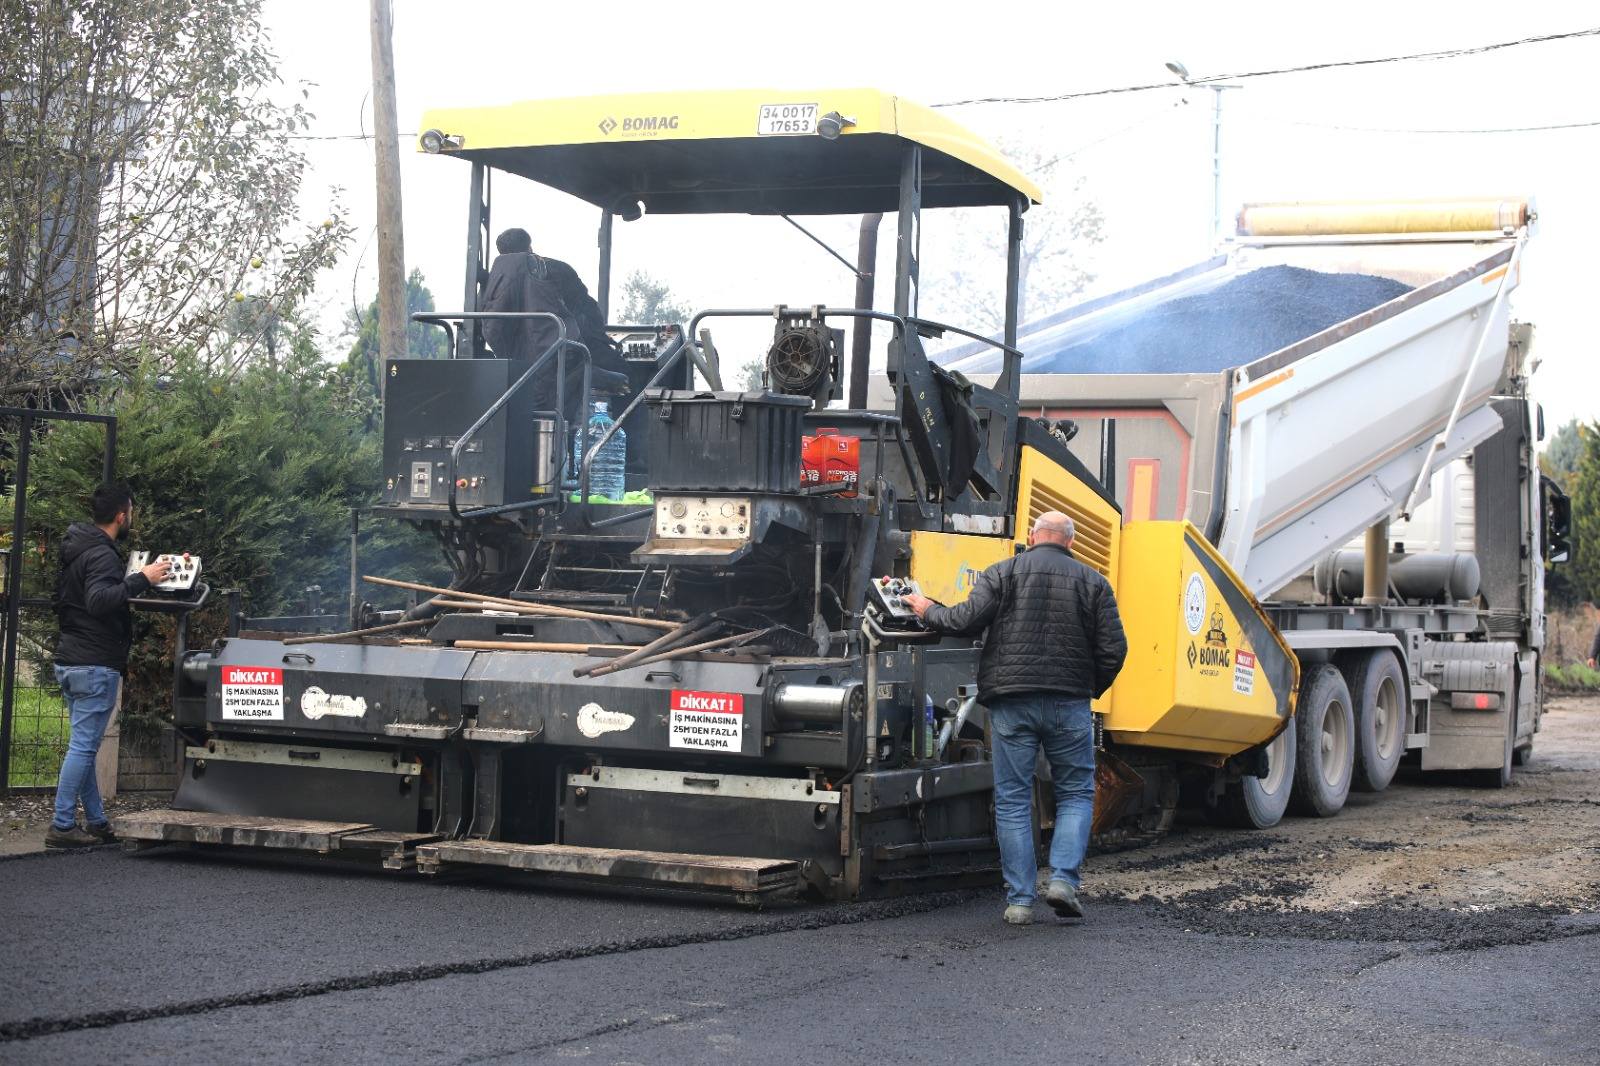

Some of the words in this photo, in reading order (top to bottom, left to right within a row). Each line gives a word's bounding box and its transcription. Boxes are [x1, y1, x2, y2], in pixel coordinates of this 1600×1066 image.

[764, 107, 778, 119] 34
[622, 116, 679, 131] BOMAG
[771, 120, 809, 132] 17653
[1200, 647, 1230, 668] BOMAG
[230, 669, 269, 683] DİKKAT
[226, 686, 233, 696] İŞ
[234, 686, 279, 696] MAKİNASINA
[225, 698, 256, 706] 25M'DEN
[256, 698, 280, 706] FAZLA
[680, 693, 727, 711] DİKKAT
[233, 709, 273, 718] YAKLAŞMA
[674, 712, 683, 723] İŞ
[684, 713, 738, 725] MAKİNASINA
[673, 725, 710, 735] 25M'DEN
[710, 727, 738, 737] FAZLA
[683, 737, 728, 748] YAKLAŞMA
